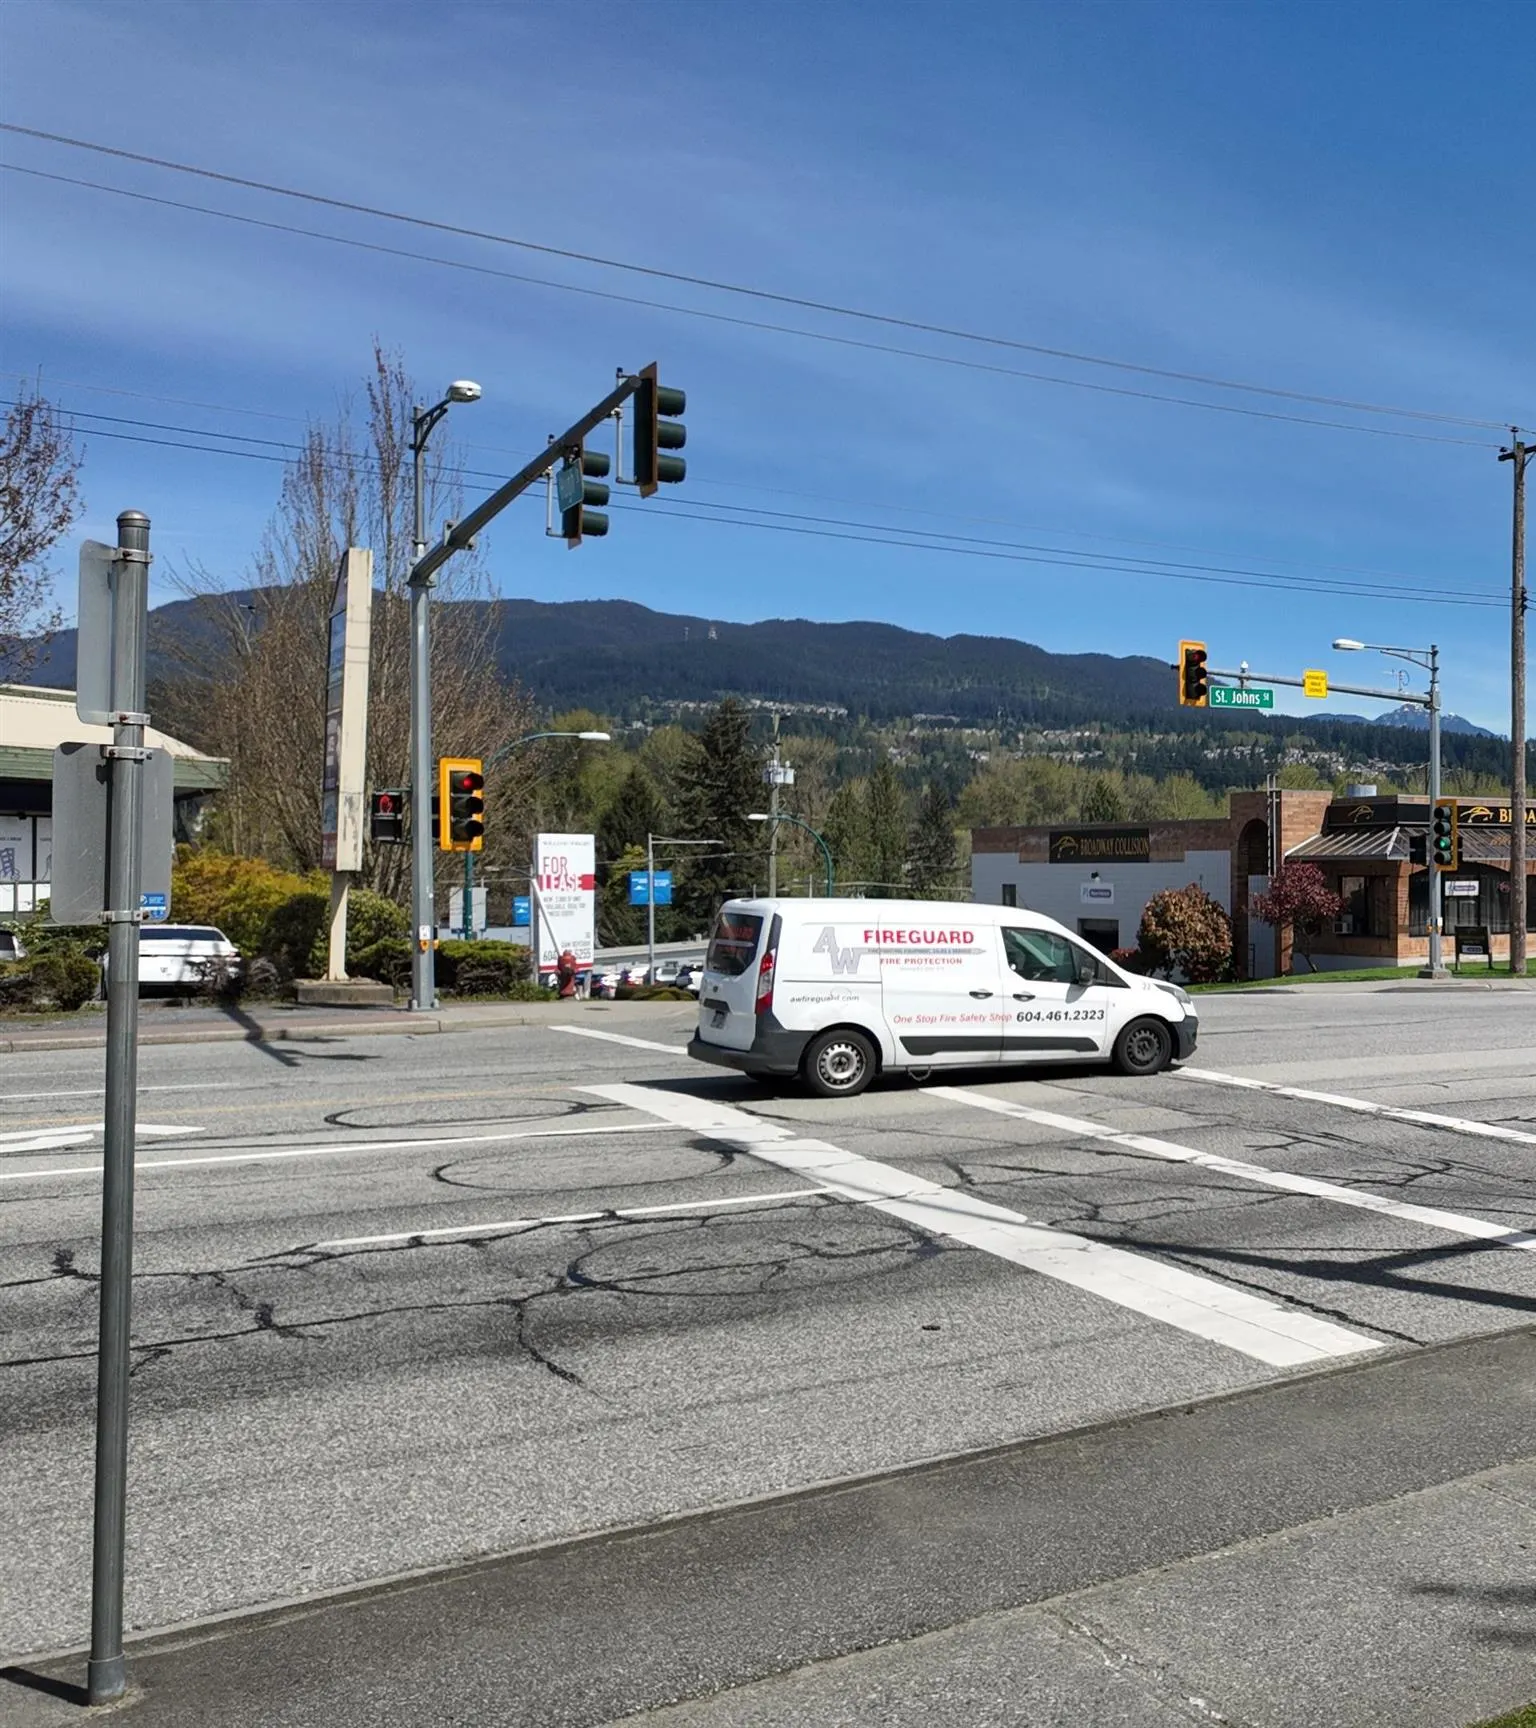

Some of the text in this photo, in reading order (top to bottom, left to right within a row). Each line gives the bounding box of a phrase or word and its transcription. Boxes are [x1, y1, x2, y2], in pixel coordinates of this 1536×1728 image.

[1215, 690, 1228, 704] St.
[1231, 691, 1260, 705] Johns
[543, 856, 568, 875] FOR
[542, 874, 583, 891] LEASE
[864, 930, 975, 944] FIREGUARD
[893, 1012, 1012, 1024] One Stop Fire Safety Shop
[1016, 1010, 1104, 1022] 604.461.2323
